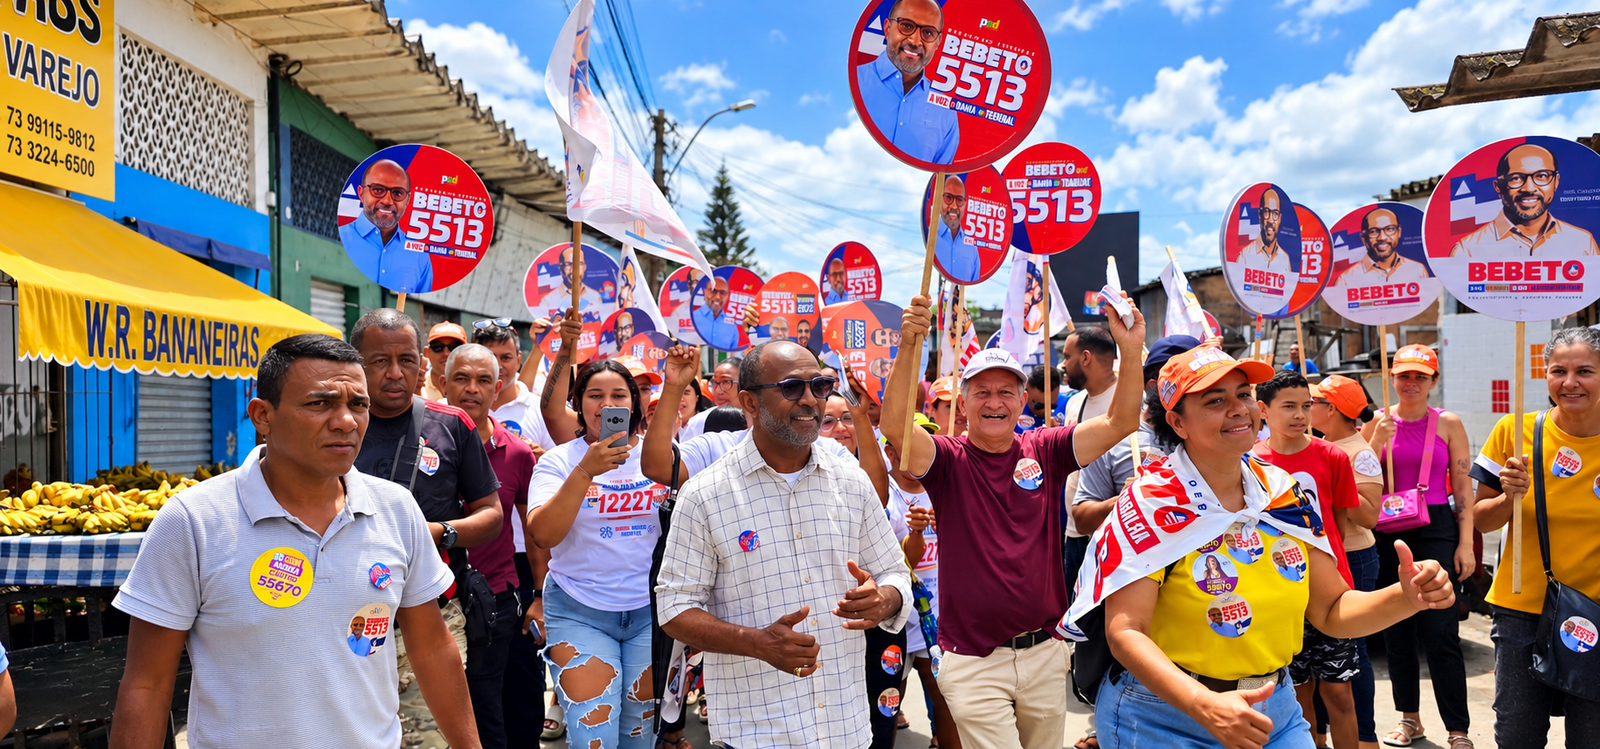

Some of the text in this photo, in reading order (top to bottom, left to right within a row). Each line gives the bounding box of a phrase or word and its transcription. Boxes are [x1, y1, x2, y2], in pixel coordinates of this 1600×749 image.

[942, 34, 1033, 76] BEBETO
[3, 32, 100, 109] VAREJO
[930, 56, 1027, 112] 5513
[7, 105, 95, 152] 73 99115-9812
[7, 134, 95, 177] 73 3224-6500
[1025, 163, 1076, 177] BEBETO
[412, 191, 487, 218] BEBETO
[1009, 189, 1093, 224] 5513
[405, 210, 484, 248] 5513
[964, 213, 1005, 242] 5513
[1244, 268, 1286, 289] BEBETO
[1468, 260, 1585, 282] BEBETO
[848, 277, 877, 294] 5513
[1347, 282, 1420, 301] BEBETO
[760, 299, 795, 314] 5513
[85, 299, 260, 369] W.R. BANANEIRAS
[599, 490, 653, 513] 12227
[257, 575, 302, 597] 55670
[364, 622, 389, 636] 5513
